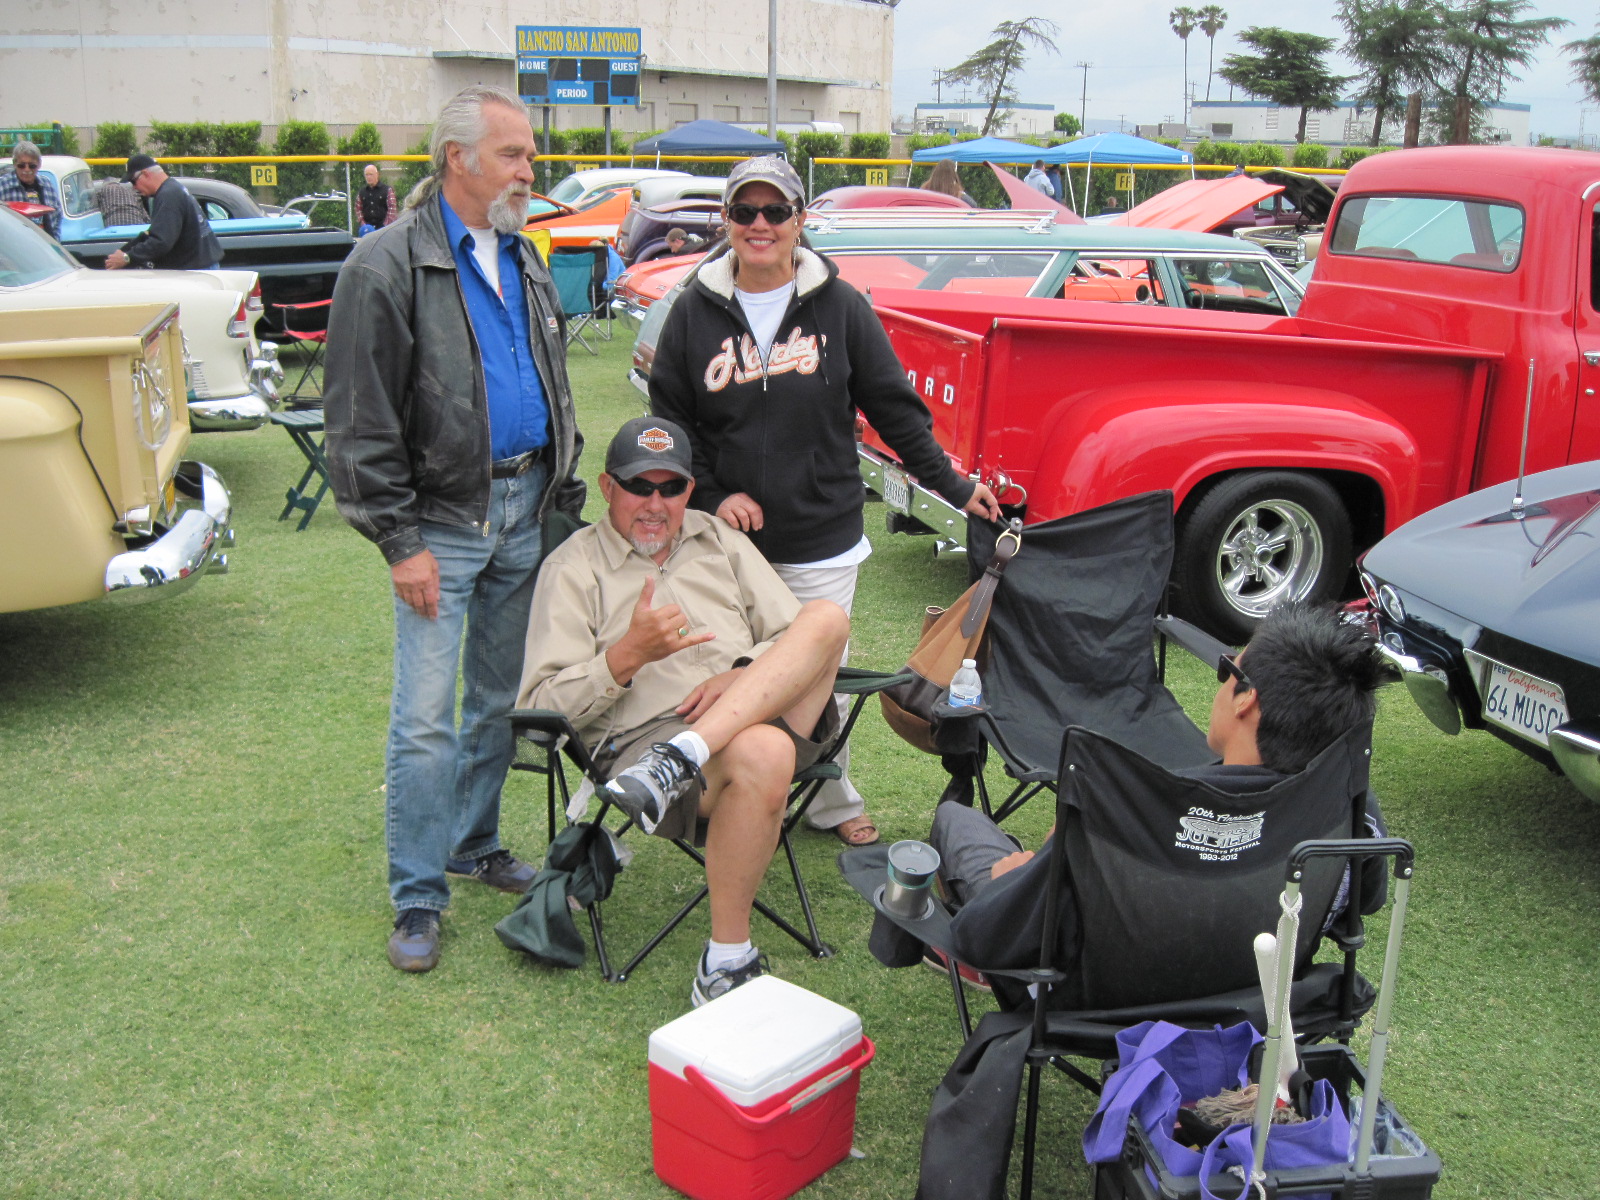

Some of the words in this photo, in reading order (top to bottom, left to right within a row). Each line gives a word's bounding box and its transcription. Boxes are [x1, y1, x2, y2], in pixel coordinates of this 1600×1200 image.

[517, 30, 564, 51] RANCHO
[565, 31, 588, 52] SAN
[590, 32, 639, 53] ANTONIO
[519, 61, 547, 70] HOME
[611, 62, 639, 72] GUEST
[556, 88, 588, 98] PERIOD
[255, 168, 273, 183] PG
[870, 171, 884, 185] FR
[907, 369, 955, 405] ORD
[1493, 664, 1507, 675] FEB
[1507, 670, 1561, 703] California
[1487, 684, 1508, 718] 64
[1187, 806, 1215, 818] 20th
[1229, 840, 1261, 853] FESTIVAL
[1198, 853, 1239, 861] 1993-2012
